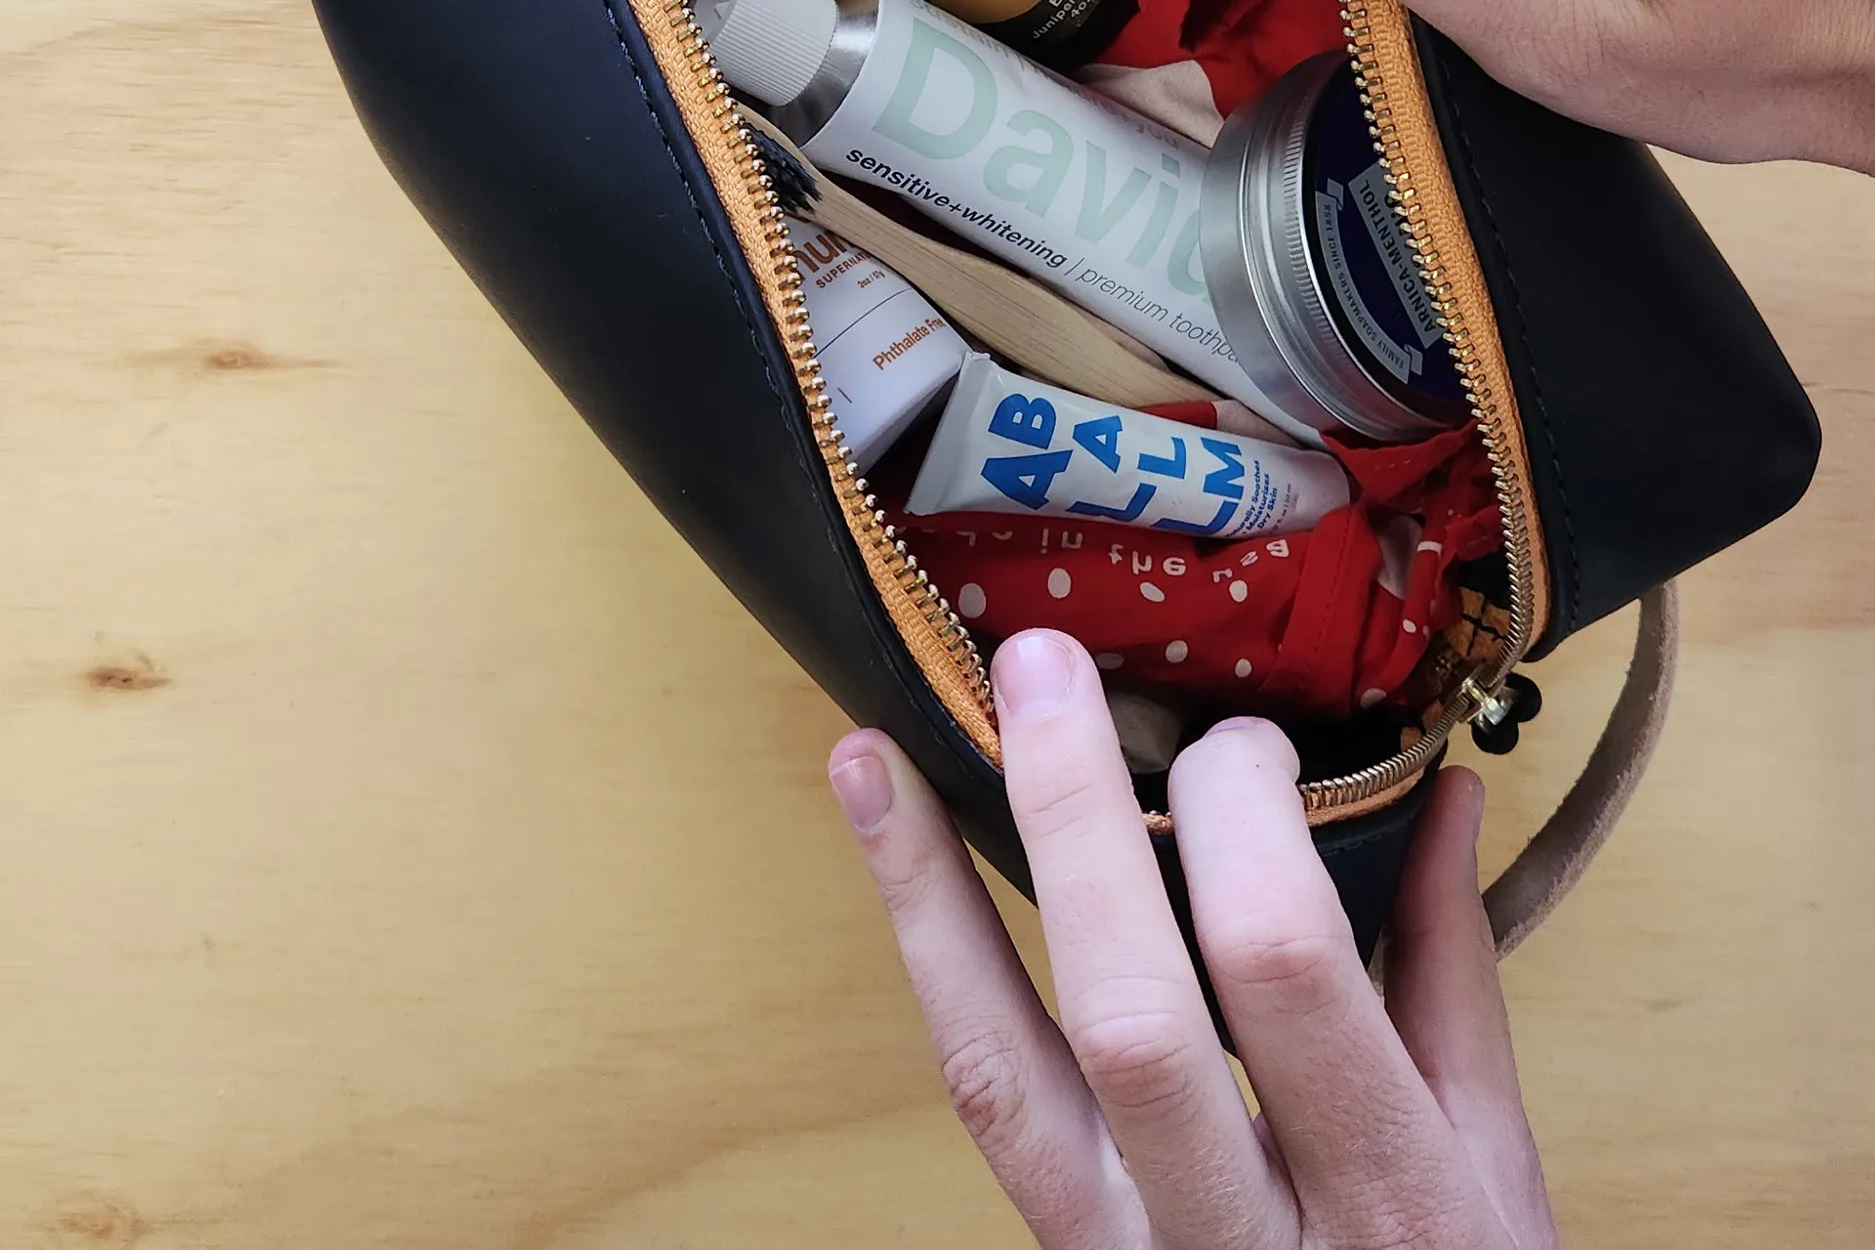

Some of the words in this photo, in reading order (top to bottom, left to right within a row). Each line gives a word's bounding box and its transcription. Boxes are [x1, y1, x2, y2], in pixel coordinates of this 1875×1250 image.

[845, 148, 1068, 268] sensitive+whitening
[1075, 268, 1169, 321] premium
[1328, 237, 1342, 270] SINCE
[1359, 179, 1437, 333] ARNICA-MENTHOL
[1338, 272, 1376, 339] SOAPMAKERS
[872, 325, 930, 371] Phthalate
[1376, 338, 1404, 370] FAMILY
[1257, 512, 1271, 530] Dry
[1267, 487, 1278, 511] Skin
